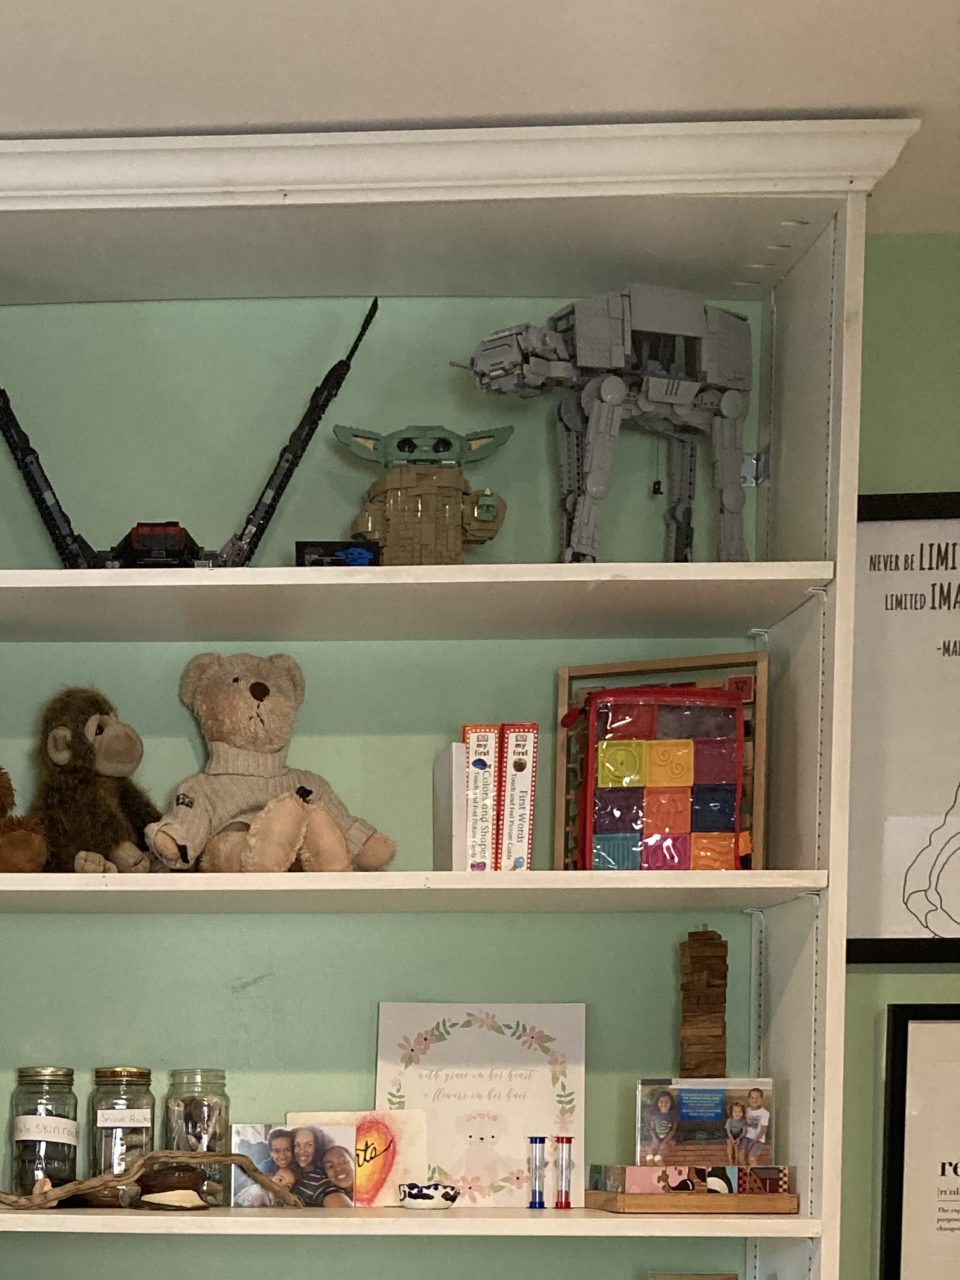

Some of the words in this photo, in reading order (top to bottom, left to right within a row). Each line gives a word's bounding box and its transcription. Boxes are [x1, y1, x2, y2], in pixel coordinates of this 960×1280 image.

[869, 554, 900, 572] NEVER
[903, 554, 915, 571] BE
[919, 542, 960, 571] LIMI
[885, 593, 926, 611] LIMITED
[482, 771, 491, 801] Colors
[519, 790, 528, 811] First
[478, 825, 489, 859] Shapes
[516, 812, 527, 844] Words
